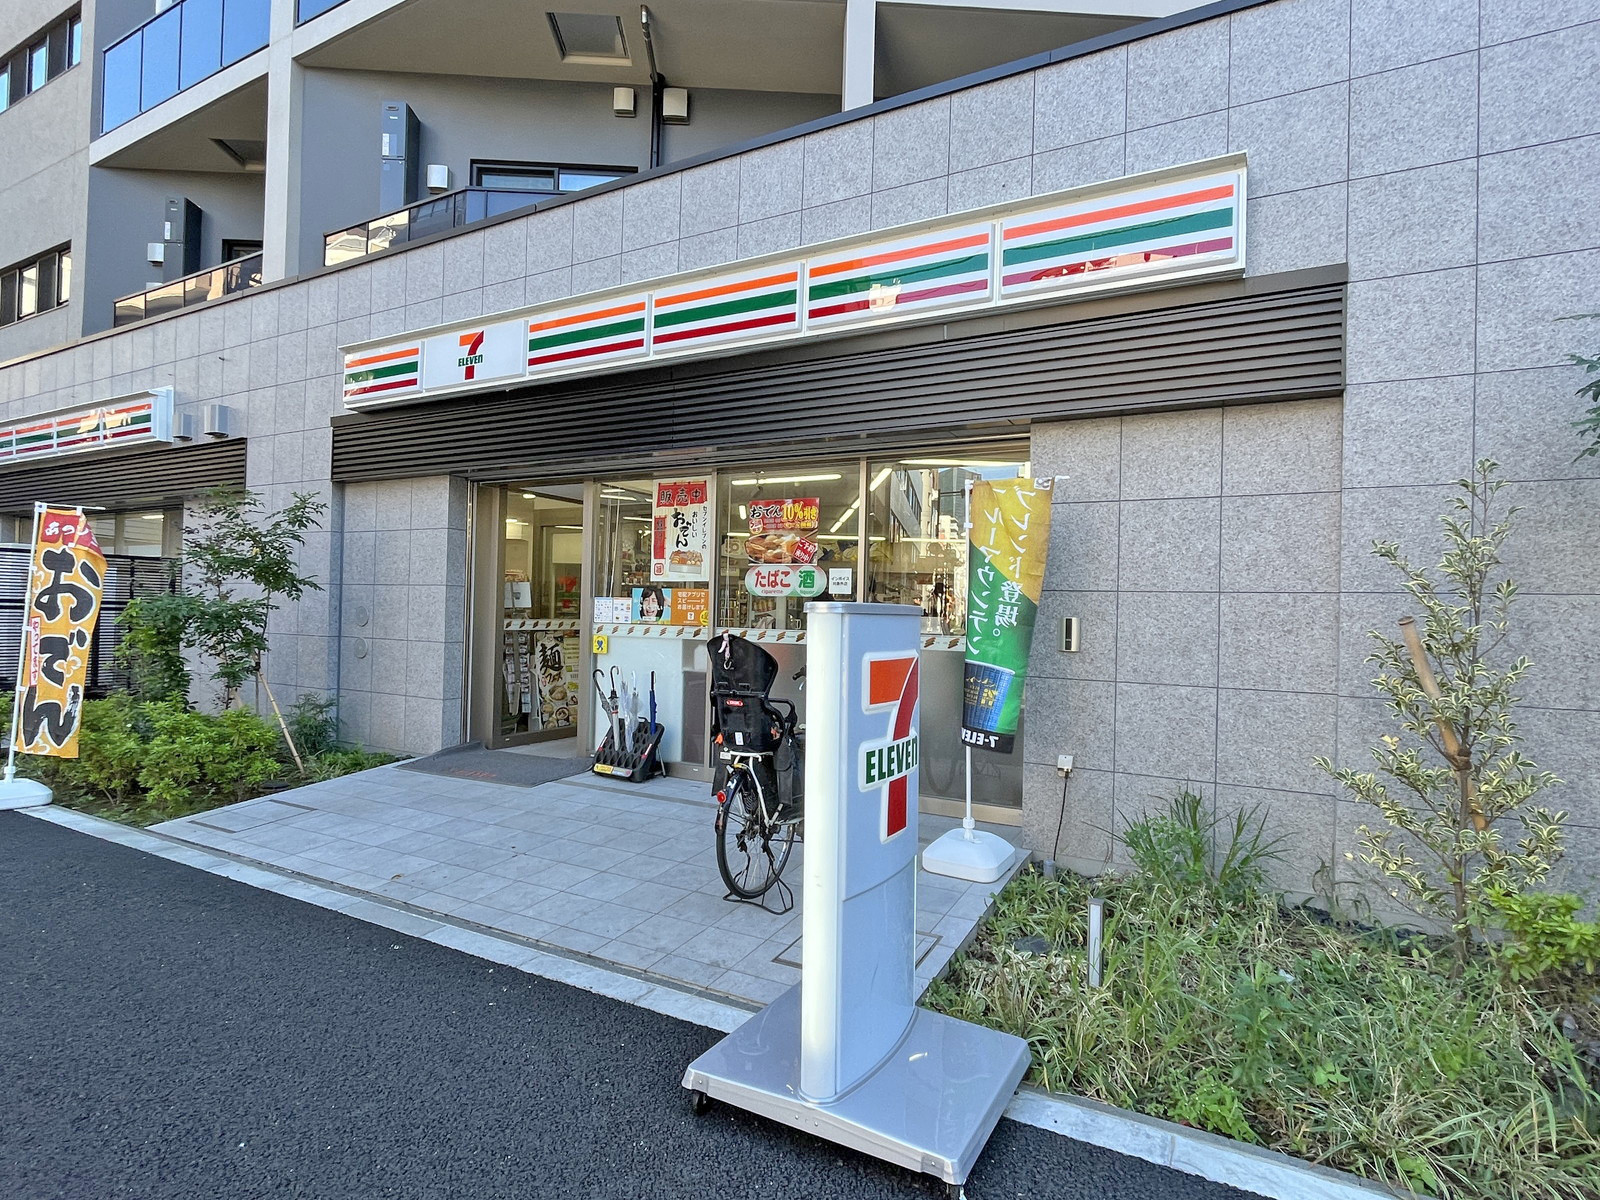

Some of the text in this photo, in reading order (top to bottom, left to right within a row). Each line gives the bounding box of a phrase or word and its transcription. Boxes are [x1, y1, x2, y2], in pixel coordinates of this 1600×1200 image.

[459, 330, 484, 380] 7
[660, 487, 702, 504] 販売中
[671, 507, 692, 548] おでん
[755, 569, 815, 588] たばこ 酒
[21, 547, 102, 749] おでん
[32, 620, 40, 683] やってます
[869, 656, 919, 838] 7
